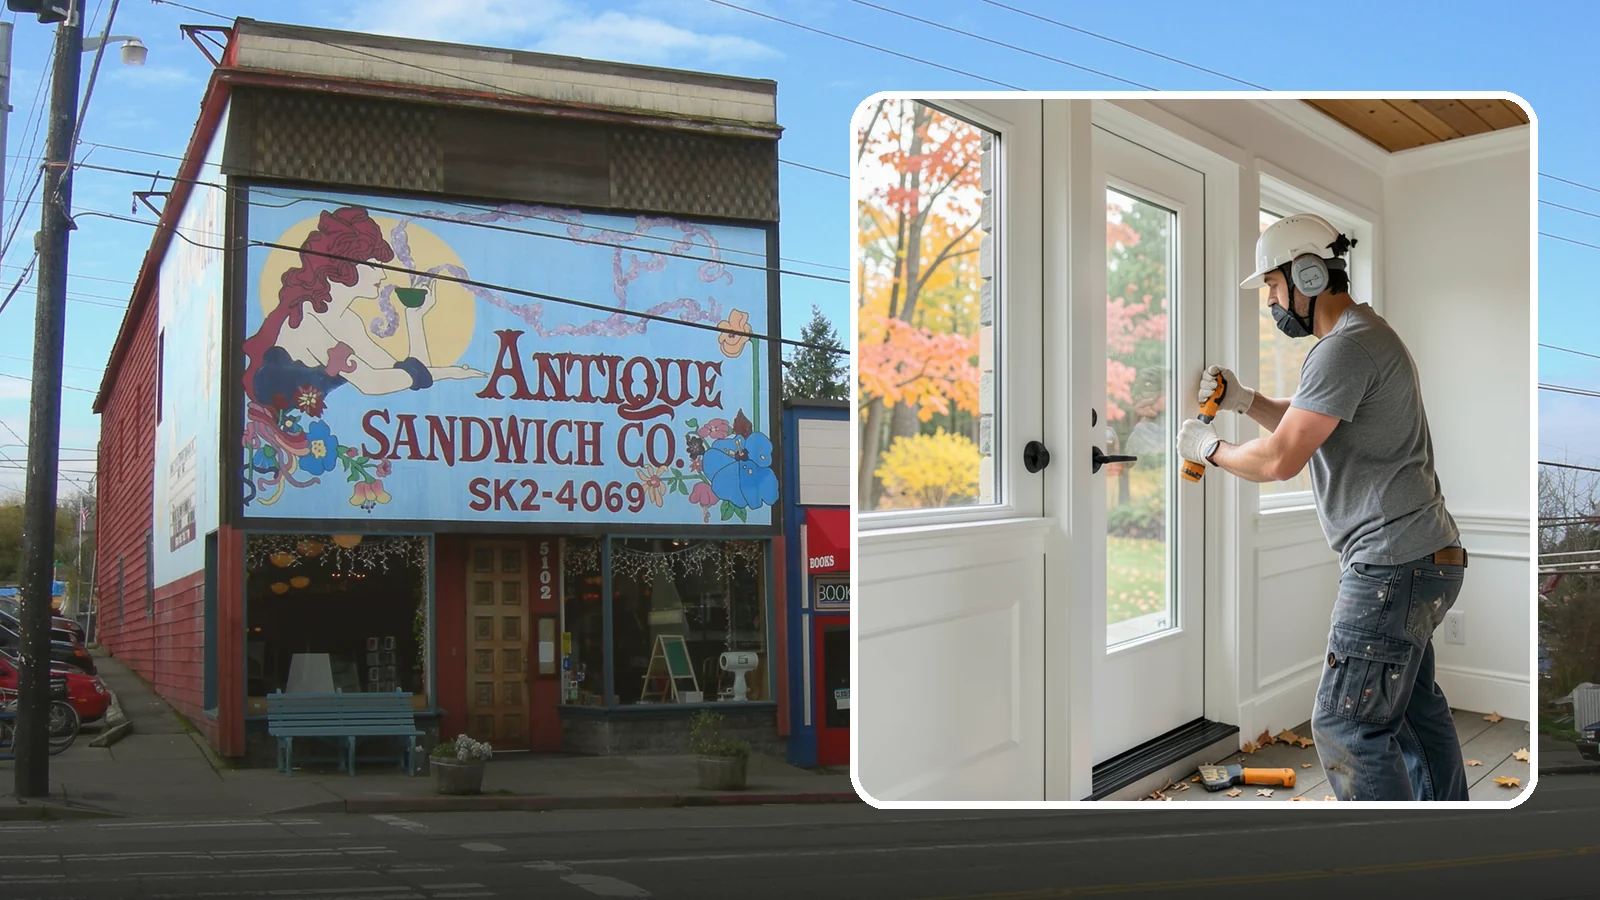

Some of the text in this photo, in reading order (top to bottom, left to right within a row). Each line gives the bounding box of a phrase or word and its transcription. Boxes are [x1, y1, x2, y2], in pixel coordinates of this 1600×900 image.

[476, 329, 724, 421] ANTIQUE
[361, 408, 685, 469] SANDWICH CO.
[468, 477, 646, 513] SK2-4069
[540, 541, 551, 600] 5102
[809, 554, 835, 570] BOOKS
